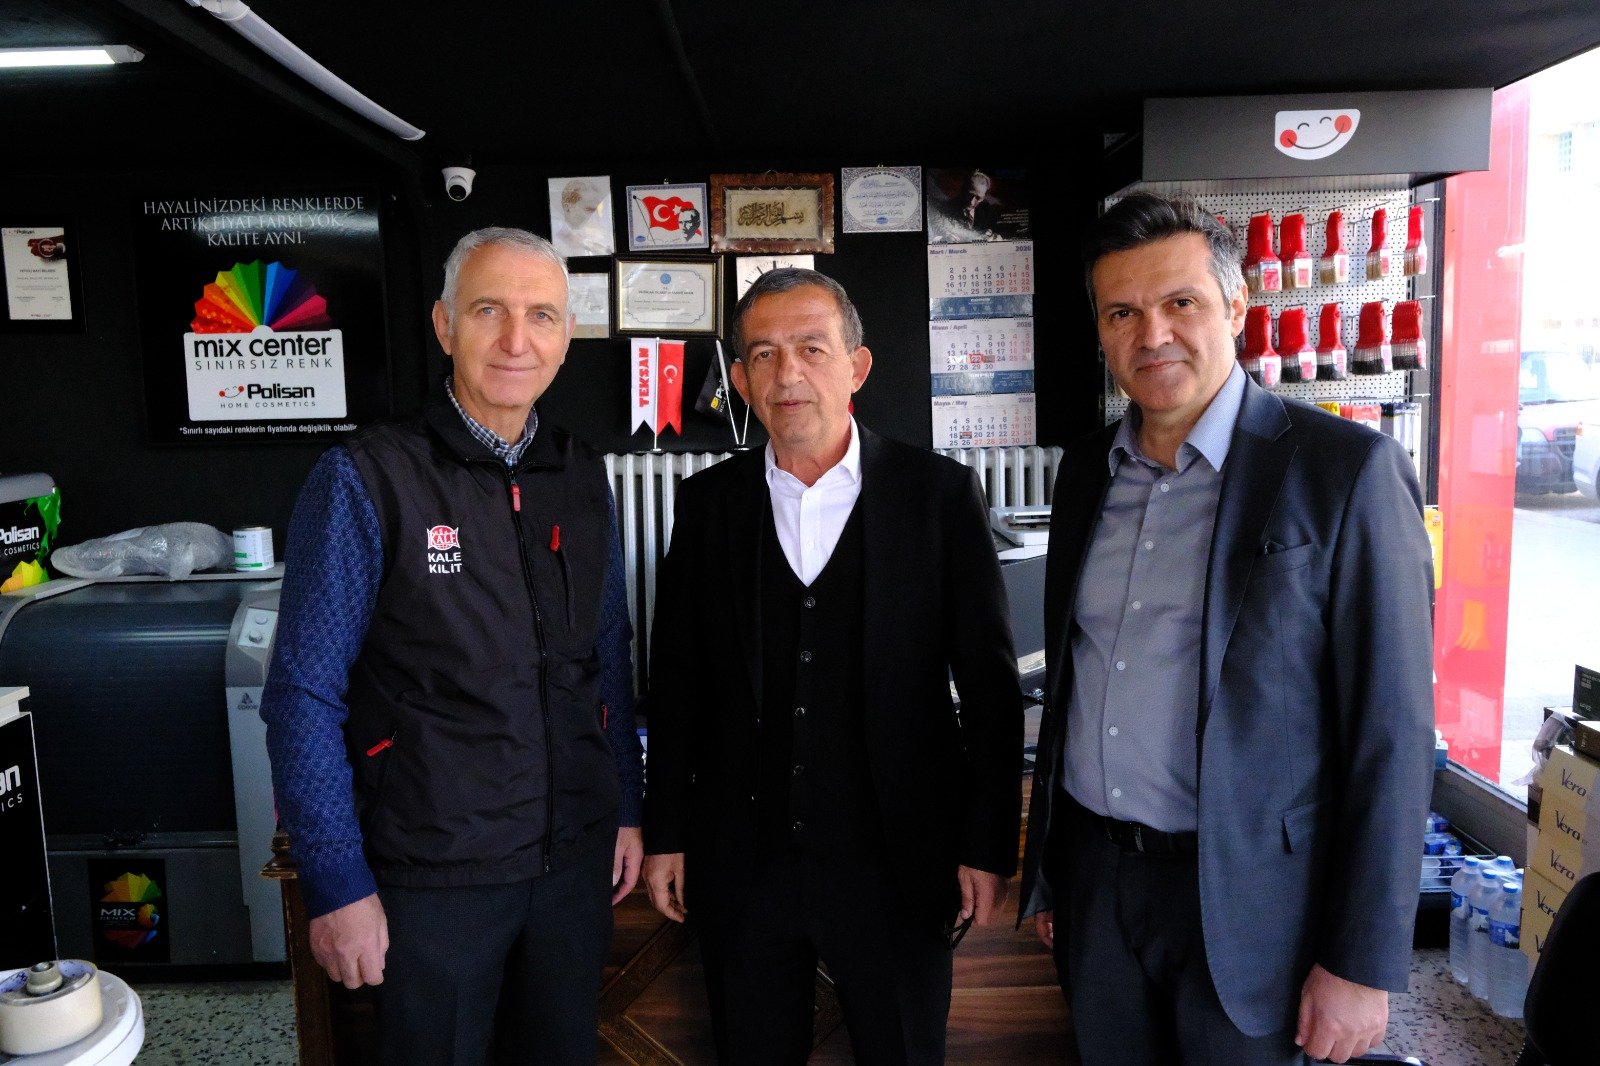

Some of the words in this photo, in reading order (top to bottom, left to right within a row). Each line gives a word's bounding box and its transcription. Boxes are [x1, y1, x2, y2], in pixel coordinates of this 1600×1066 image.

[143, 198, 267, 215] HAYALİNİZDEKİ
[272, 196, 364, 211] RENKLERDE
[161, 216, 208, 231] ARTIK
[212, 214, 253, 229] FİYAT
[258, 213, 304, 227] FARKI
[207, 232, 259, 246] KALİTE
[264, 231, 306, 245] AYNI.
[194, 339, 243, 358] mix
[249, 335, 332, 357] center
[195, 360, 278, 370] SINIRSIZ
[287, 358, 332, 368] RENK
[639, 347, 650, 407] TEKSAN
[247, 383, 315, 399] Polisan
[204, 426, 233, 435] sayıdaki
[267, 425, 296, 434] fiyatında
[4, 543, 40, 556] COSMETICS
[428, 552, 461, 562] KALE
[1561, 768, 1586, 797] Vera
[1555, 810, 1580, 842] Vera
[1550, 849, 1576, 880] Vera
